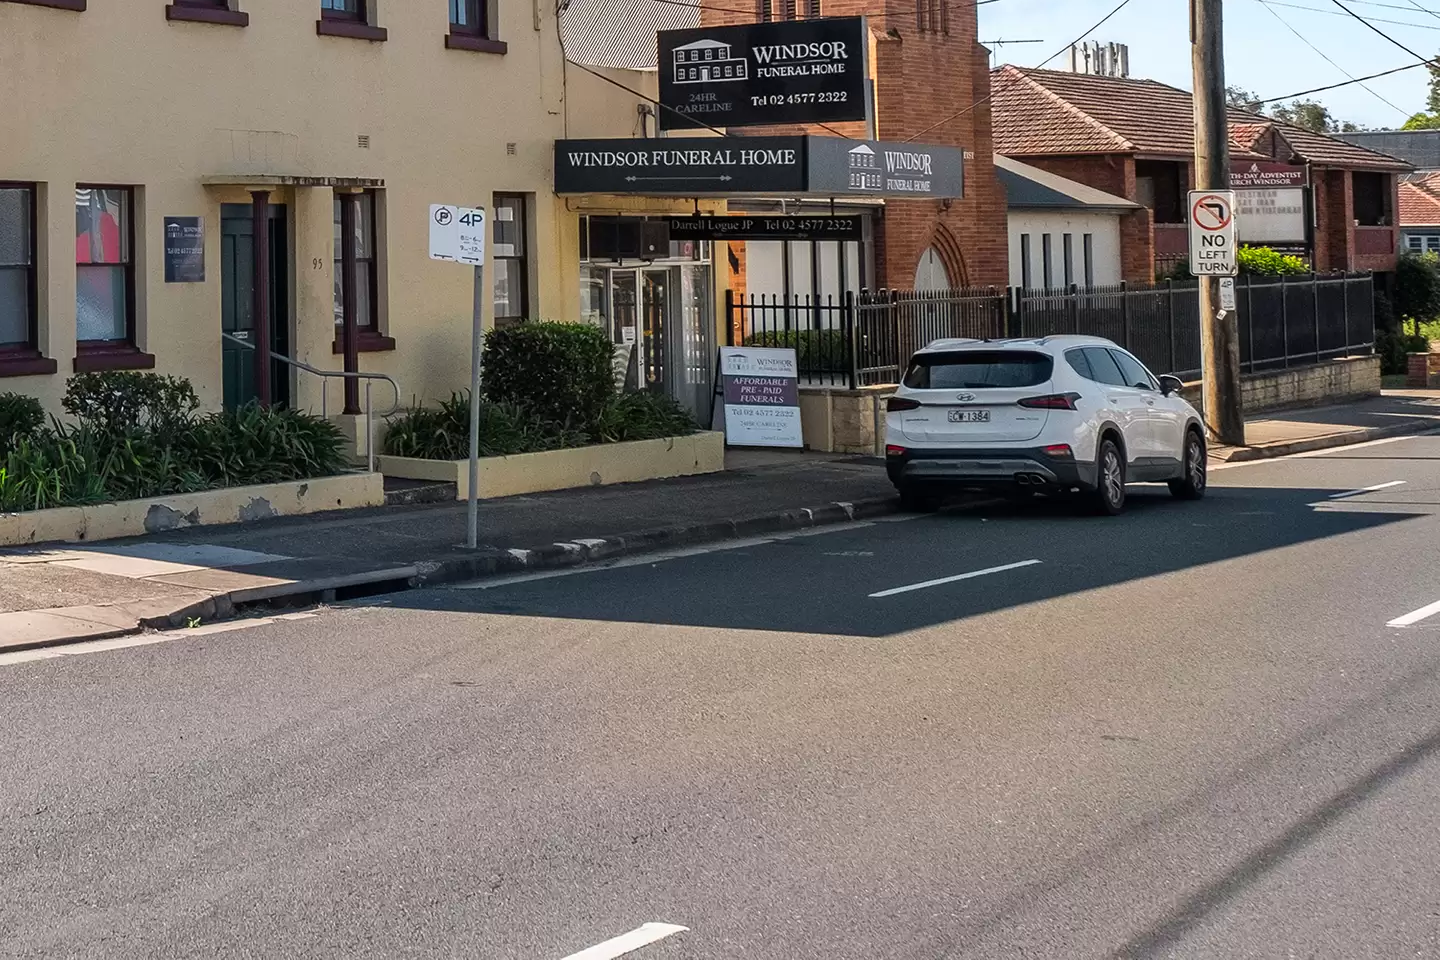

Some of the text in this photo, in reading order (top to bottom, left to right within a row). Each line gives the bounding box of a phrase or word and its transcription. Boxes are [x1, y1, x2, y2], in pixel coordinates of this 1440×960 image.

[752, 41, 848, 65] WINDSOR
[757, 63, 845, 78] FUNERAL HOME
[689, 93, 717, 102] 24HR
[751, 91, 847, 106] Tel 02 4577 2322
[675, 103, 732, 114] CARELINE
[568, 149, 796, 167] WINDSOR FUNERAL HOME
[885, 151, 932, 175] WINDSOR
[1260, 171, 1301, 179] ADVENTIST
[887, 179, 931, 191] FUNERAL HOME
[459, 213, 483, 227] 4P
[671, 220, 853, 232] Darrell Logue JP Tel 02 4577 2322
[1202, 235, 1225, 247] NO
[1199, 250, 1227, 260] LEFT
[312, 257, 323, 270] 95
[1198, 262, 1229, 271] TURN
[733, 377, 788, 386] AFFORDABLE
[740, 395, 784, 403] FUNERALS
[755, 409, 773, 417] 4577
